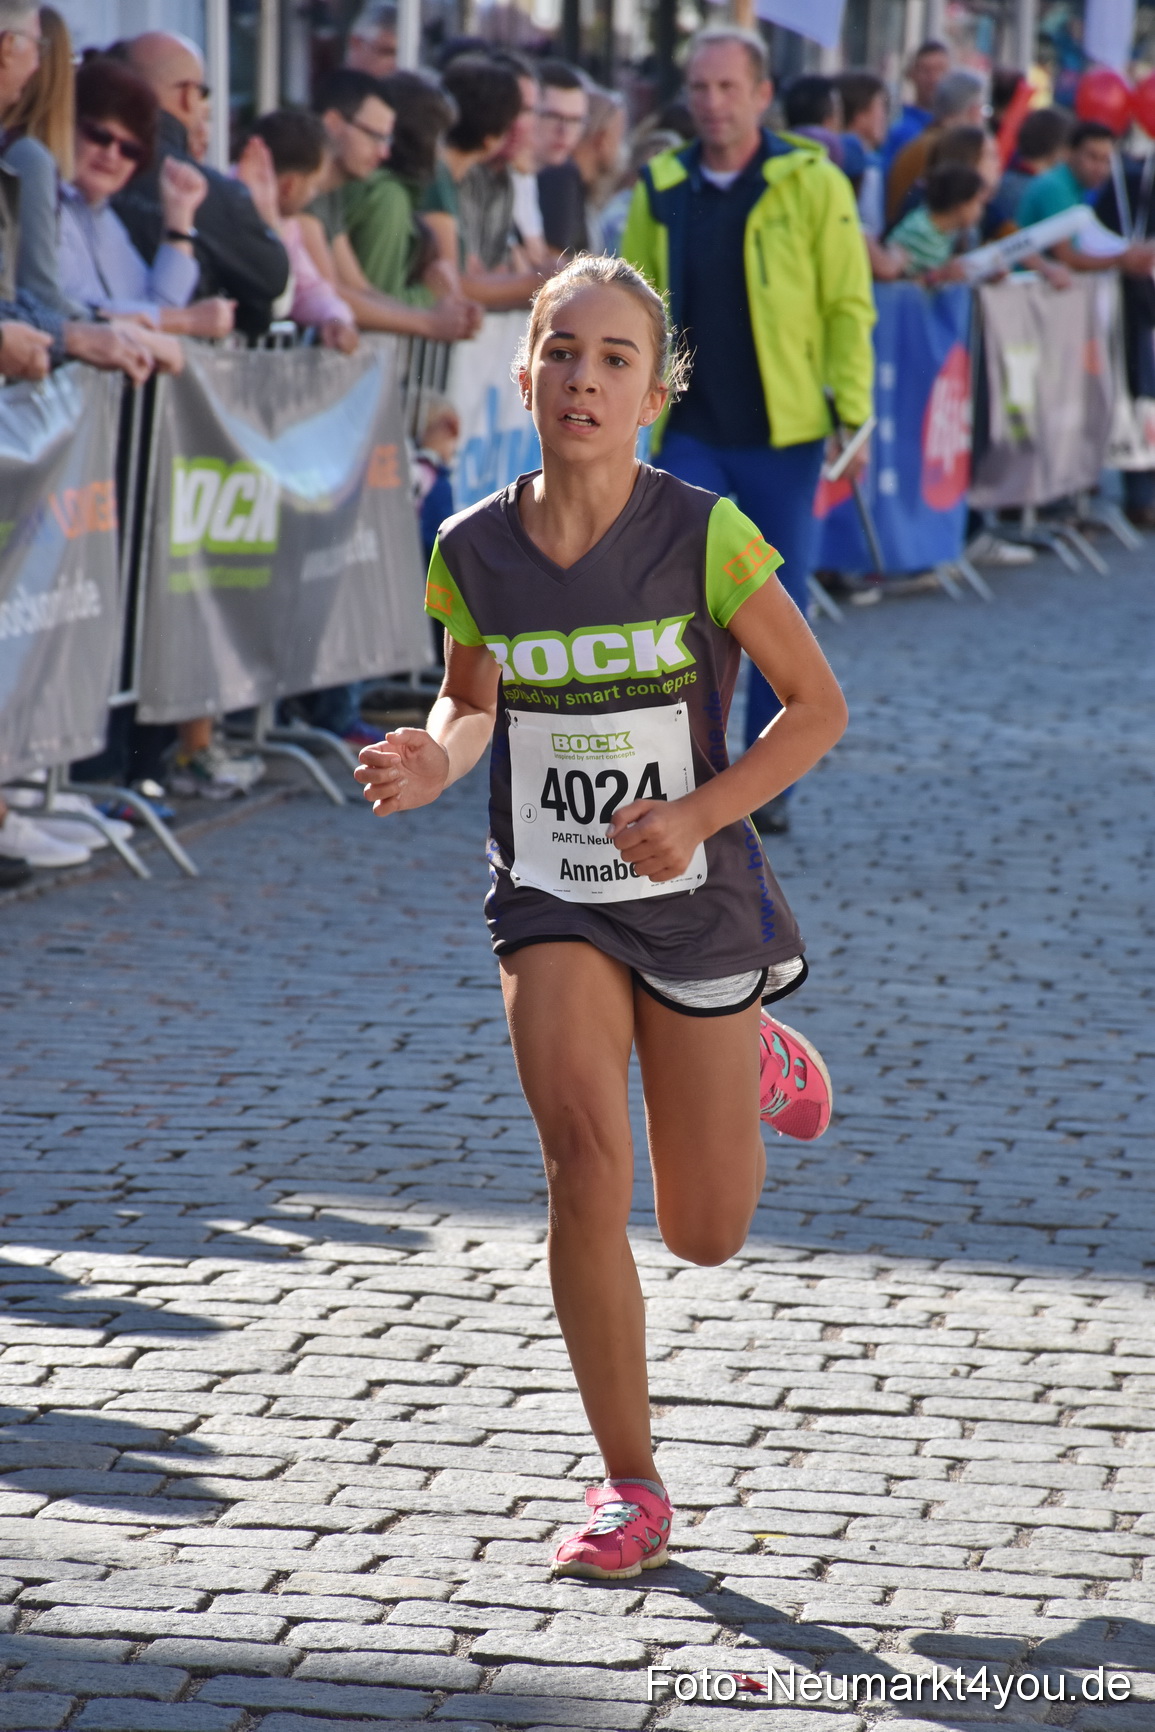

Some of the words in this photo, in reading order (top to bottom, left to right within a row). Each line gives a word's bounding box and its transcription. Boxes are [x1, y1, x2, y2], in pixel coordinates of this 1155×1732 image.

[541, 690, 560, 709] by
[565, 685, 621, 706] smart
[625, 670, 698, 694] concepts
[551, 731, 634, 753] BOCK
[554, 753, 576, 761] inspired
[576, 753, 585, 762] by
[605, 750, 636, 761] concepts
[540, 761, 668, 825] 4024
[525, 808, 533, 819] J
[552, 832, 586, 845] PARTL
